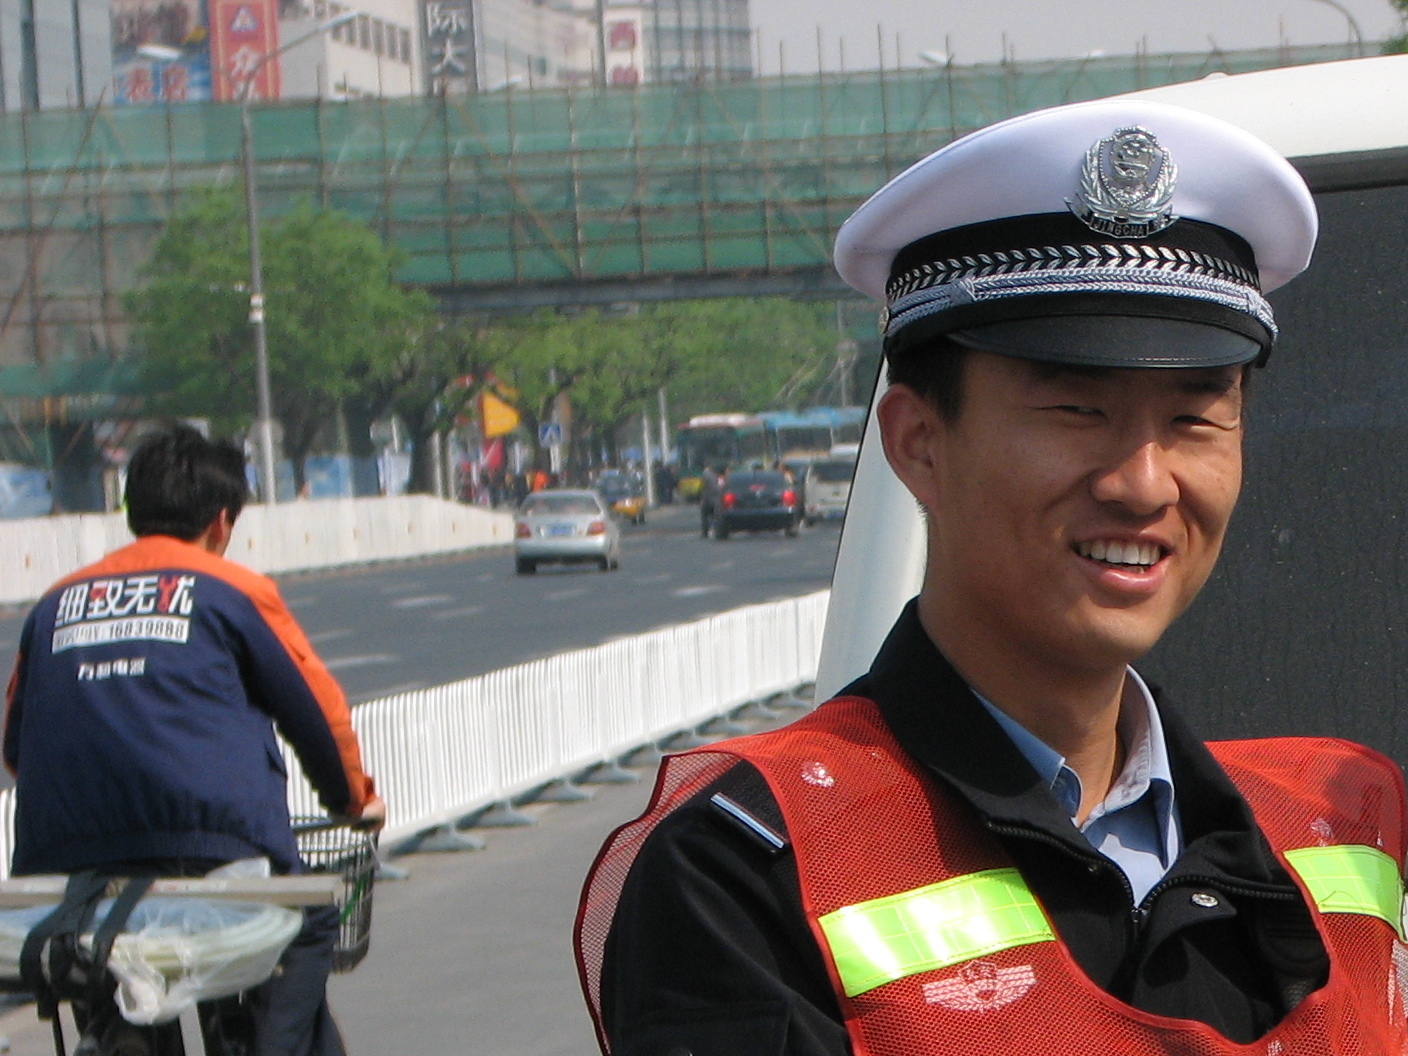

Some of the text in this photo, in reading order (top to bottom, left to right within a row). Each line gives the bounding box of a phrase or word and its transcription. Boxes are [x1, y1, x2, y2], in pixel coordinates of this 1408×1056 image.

[1092, 217, 1146, 236] JINGCHA
[54, 575, 195, 628] 细致无忧
